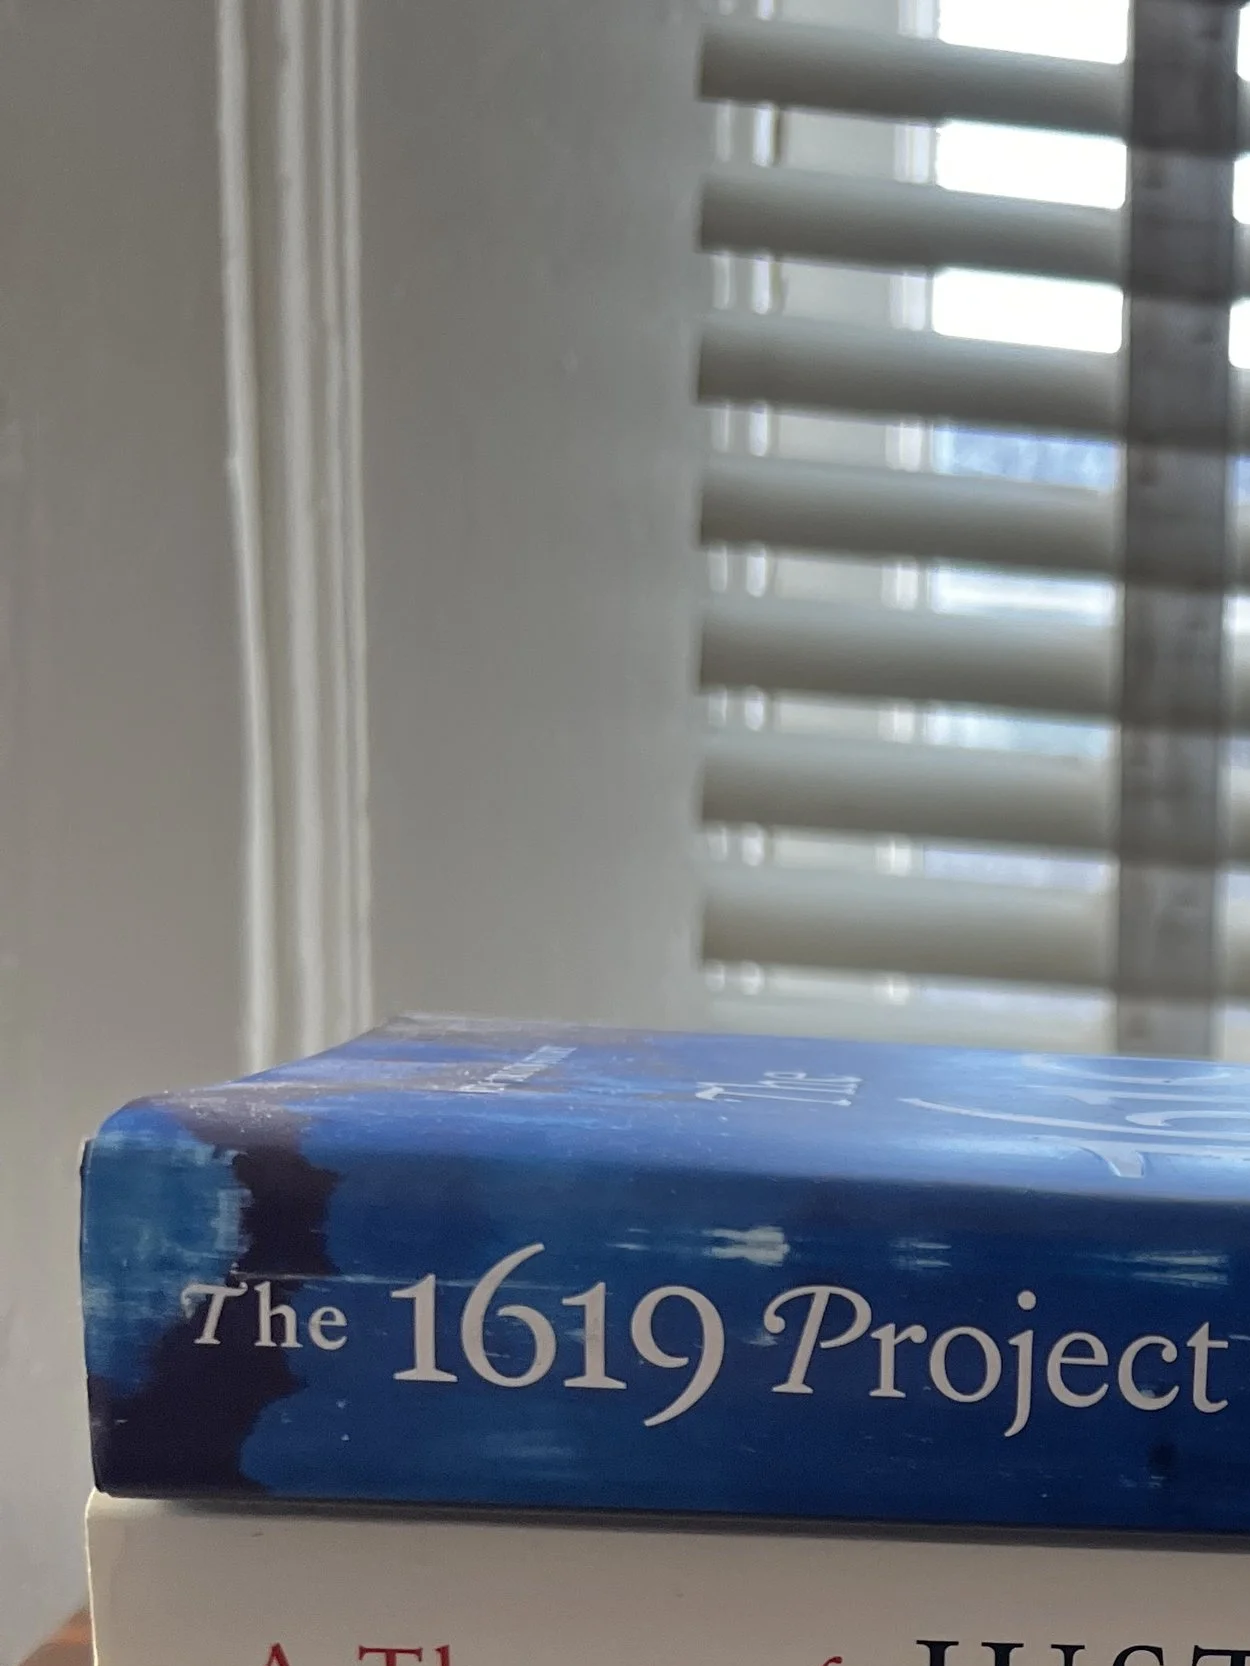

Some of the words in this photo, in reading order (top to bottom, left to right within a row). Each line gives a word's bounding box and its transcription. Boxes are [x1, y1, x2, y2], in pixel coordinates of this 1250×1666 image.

[180, 1280, 349, 1351] The
[391, 1243, 725, 1427] 1619
[763, 1285, 1229, 1437] Project
